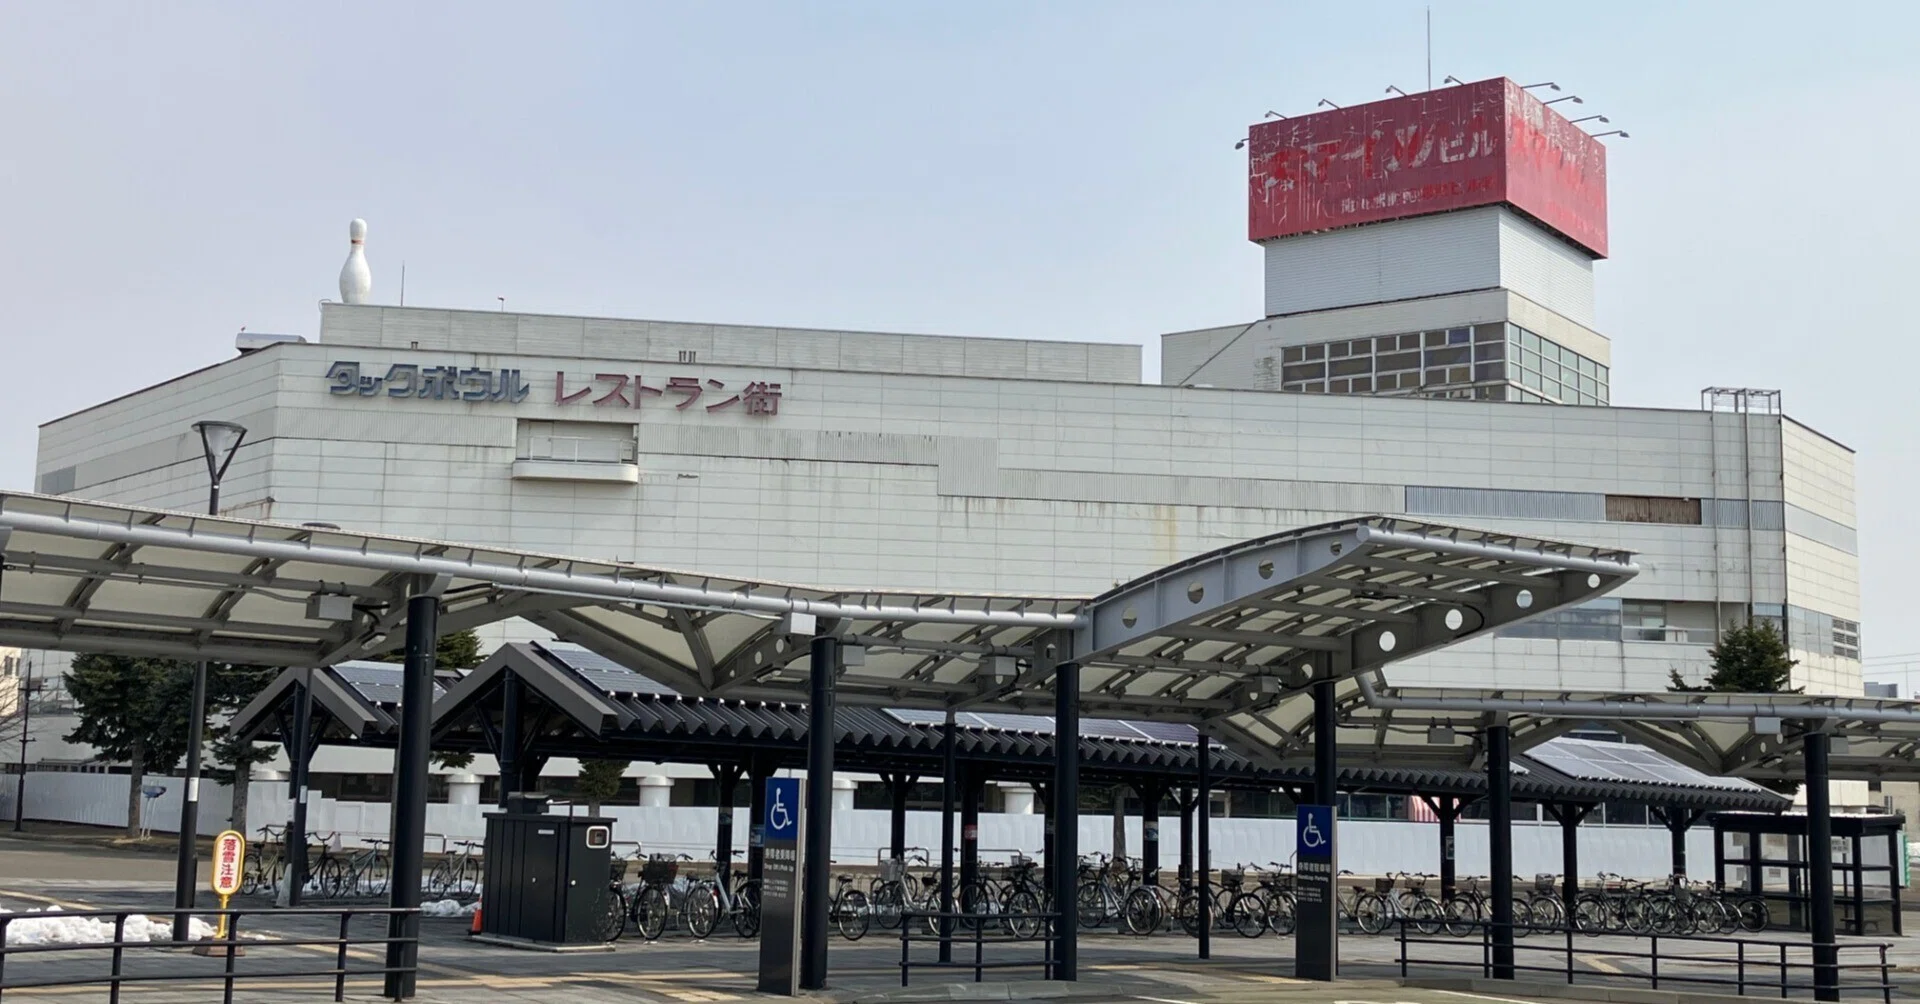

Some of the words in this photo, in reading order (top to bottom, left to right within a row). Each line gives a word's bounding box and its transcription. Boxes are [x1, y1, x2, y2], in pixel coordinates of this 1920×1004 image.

[326, 361, 530, 404] タックボウル
[555, 370, 783, 416] レストラン街
[220, 838, 236, 889] 落雪注意
